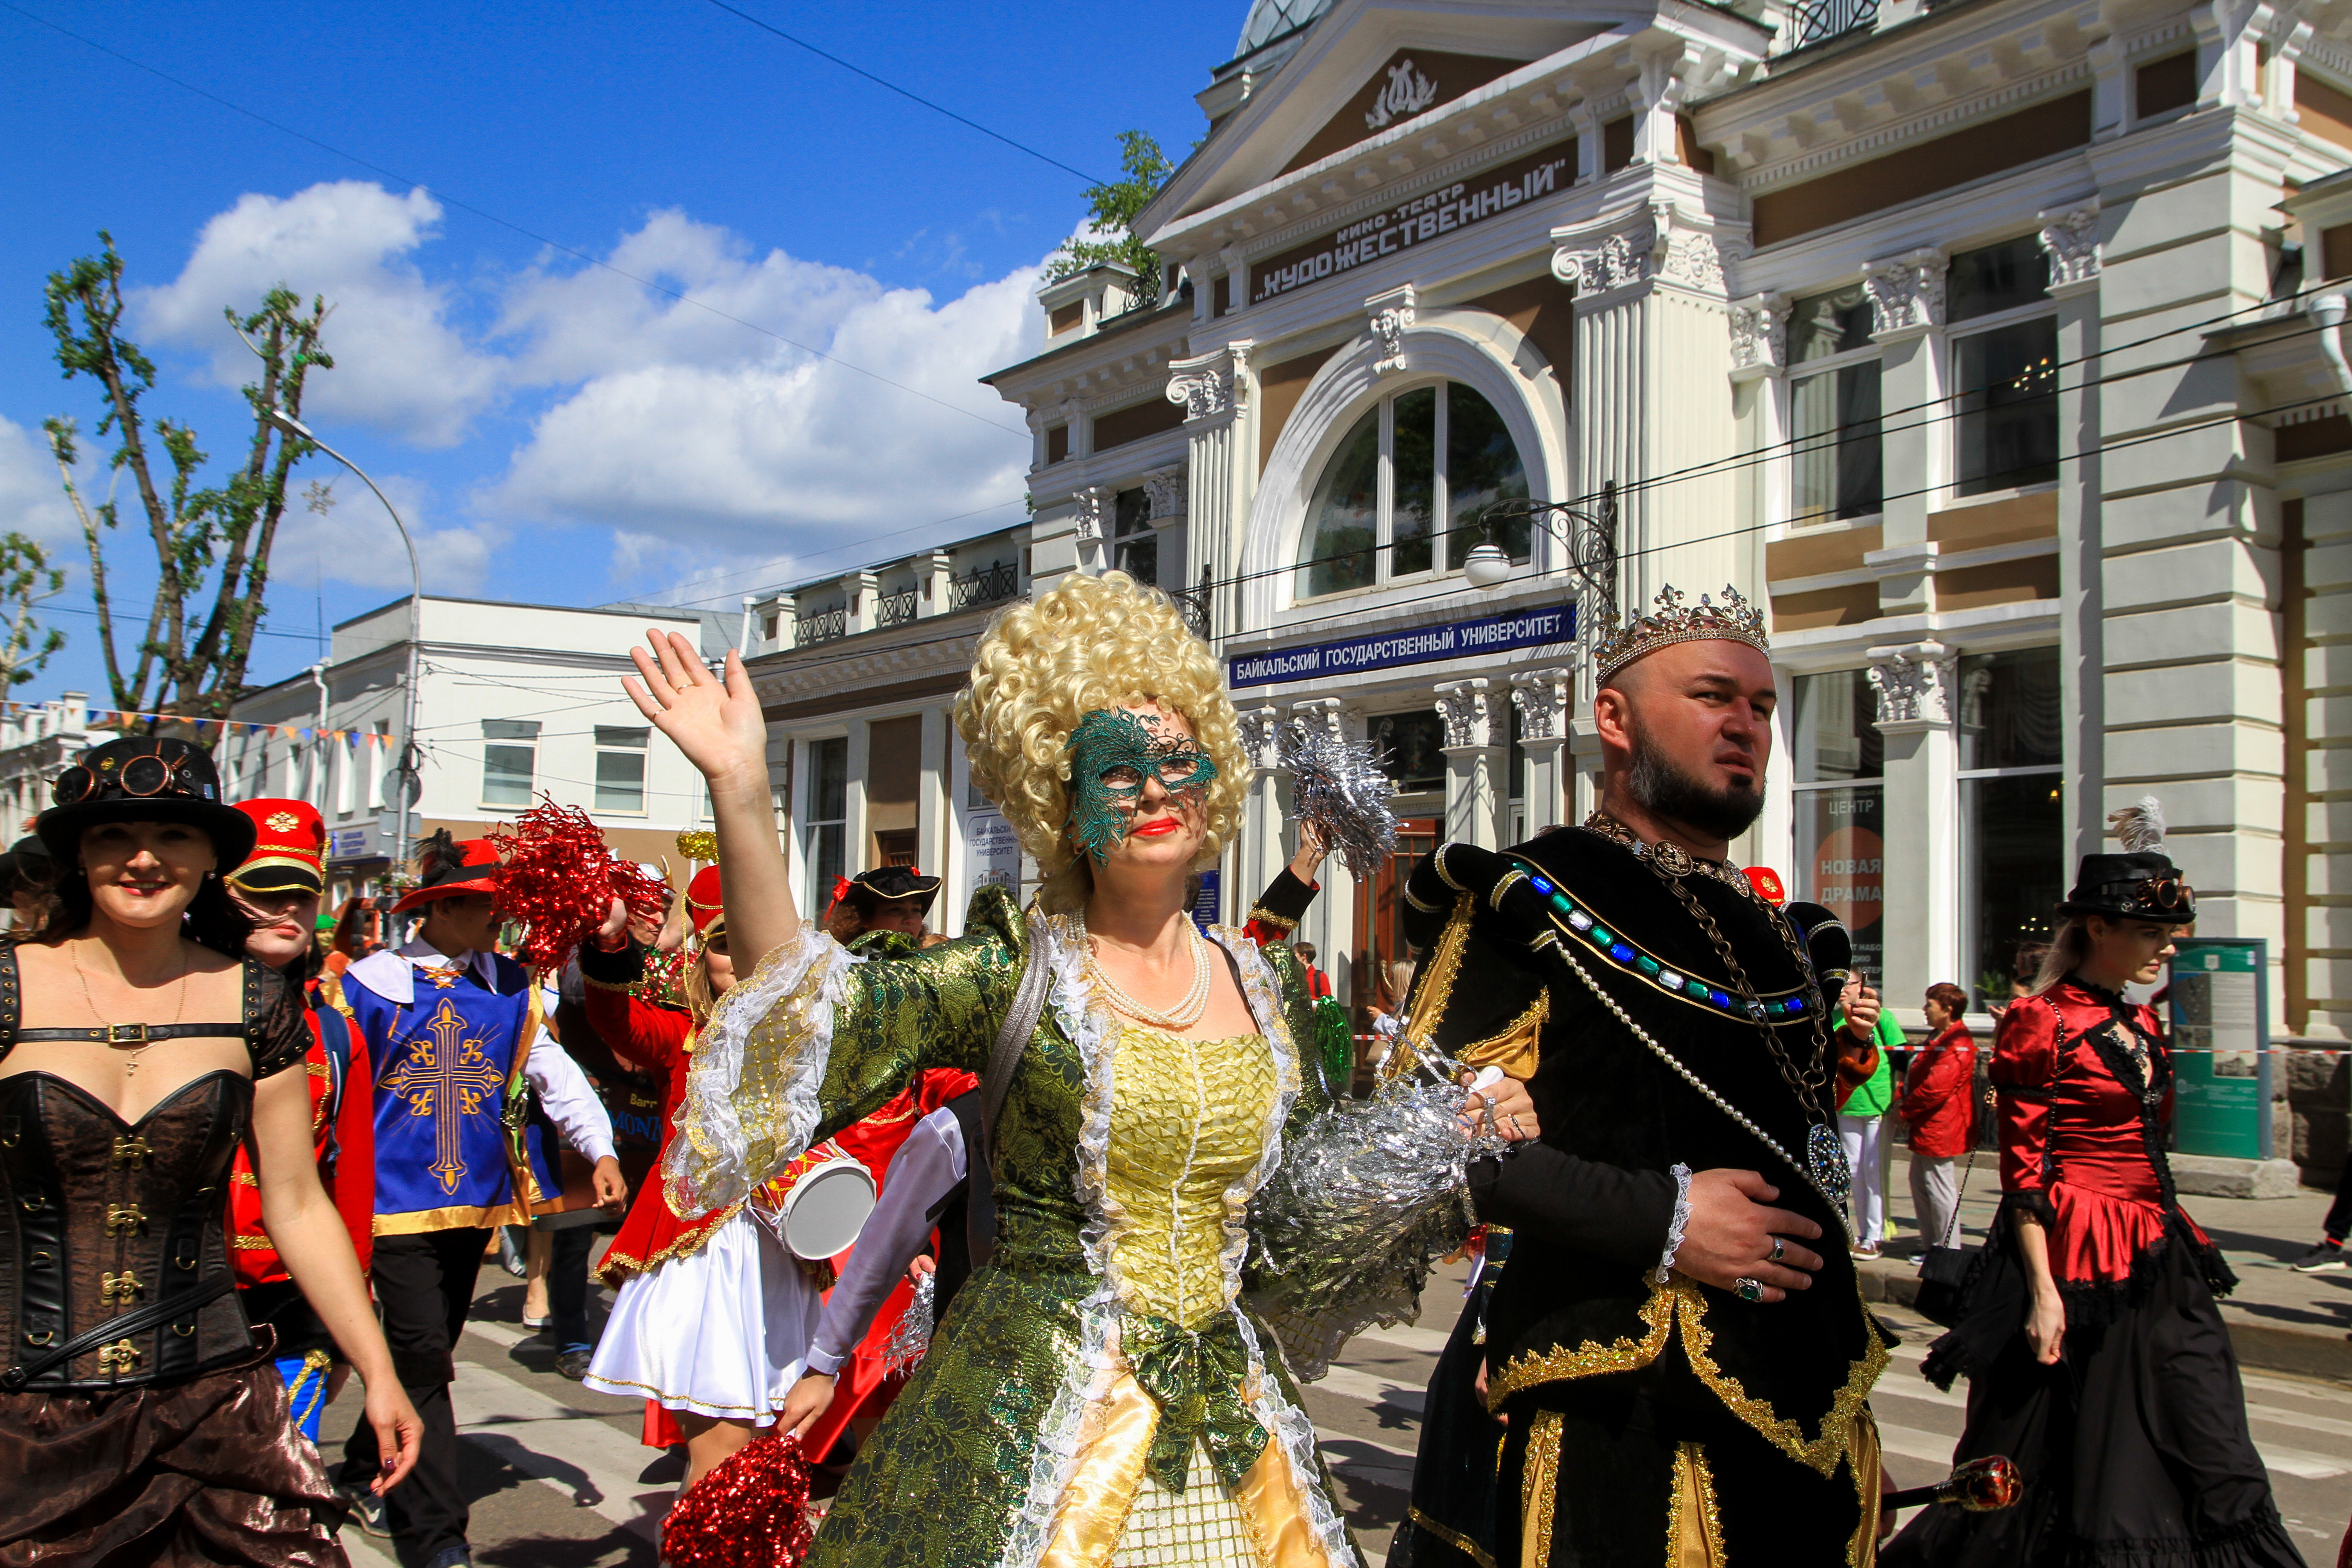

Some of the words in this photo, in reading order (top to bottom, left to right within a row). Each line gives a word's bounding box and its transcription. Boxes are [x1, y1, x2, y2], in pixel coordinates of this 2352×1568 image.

[1237, 648, 1320, 680] БАЙКАЛЬСКИЙ
[1326, 626, 1455, 667] ГОСУДАРСТВЕННЫЙ
[1461, 614, 1562, 647] УНИВЕРСИТЕТ
[1829, 799, 1874, 816] ЦЕНТР
[976, 825, 1013, 835] БАЙКАЛЬСКИ
[969, 835, 1019, 847] ГОСУДАРСТВЕННЫ
[976, 846, 1013, 857] УНИВЕРСИТЕТ
[1822, 858, 1882, 875] НОВАЯ
[1820, 886, 1883, 905] ДРАМА
[630, 1093, 658, 1108] Barr
[608, 1110, 663, 1141] MONK
